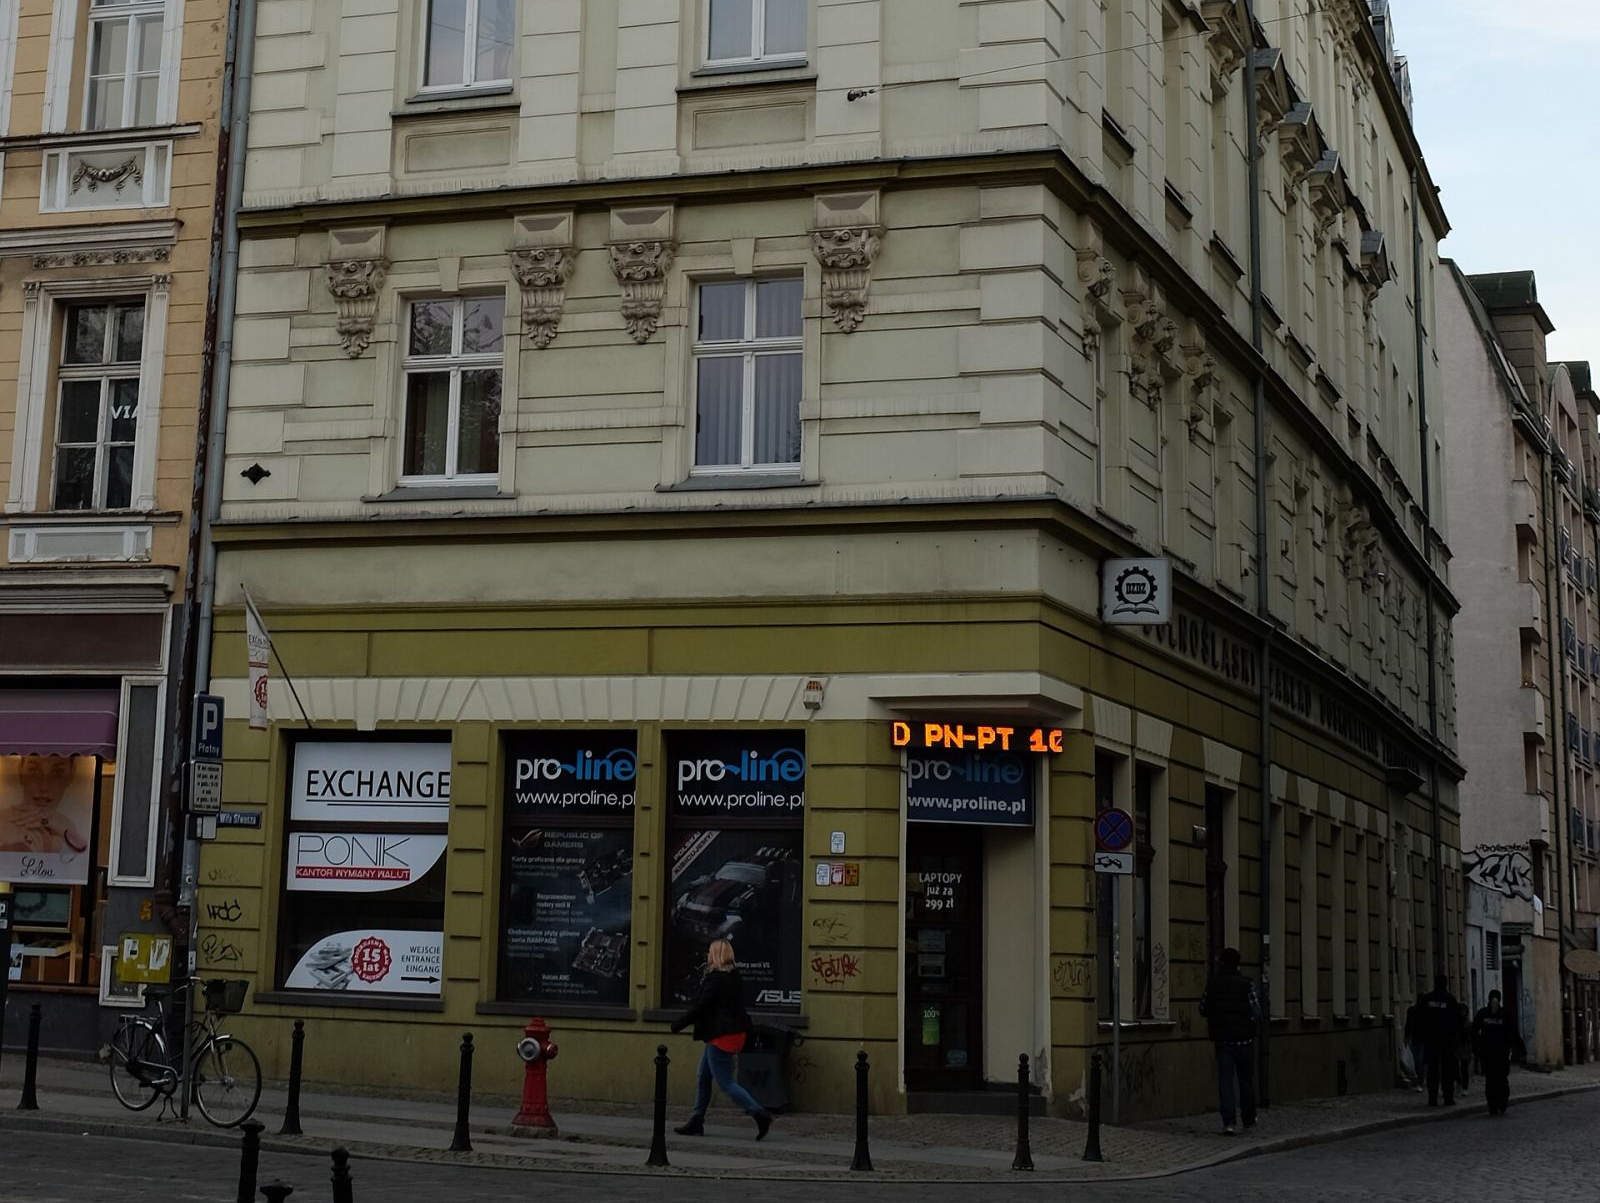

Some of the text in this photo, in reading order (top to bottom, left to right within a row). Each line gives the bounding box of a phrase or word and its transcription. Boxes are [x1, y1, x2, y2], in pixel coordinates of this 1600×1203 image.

[1125, 582, 1146, 595] DZDZ
[202, 702, 217, 740] P
[925, 724, 1014, 751] PN-PT
[306, 770, 451, 798] EXCHANGE
[515, 790, 636, 809] www.proline.pl
[678, 792, 804, 810] www.proline.pl
[907, 796, 1026, 814] www.proline.pl
[297, 835, 411, 867] PONIK
[297, 868, 409, 880] KANTOR WYMIANY WALUT
[919, 873, 963, 884] LAPTOPY
[942, 886, 953, 896] za
[925, 899, 943, 910] 299
[362, 948, 381, 962] 15
[401, 956, 440, 964] ENTRANCE
[362, 962, 380, 972] lat
[405, 965, 440, 974] EINGANG
[755, 989, 802, 1003] ASUS
